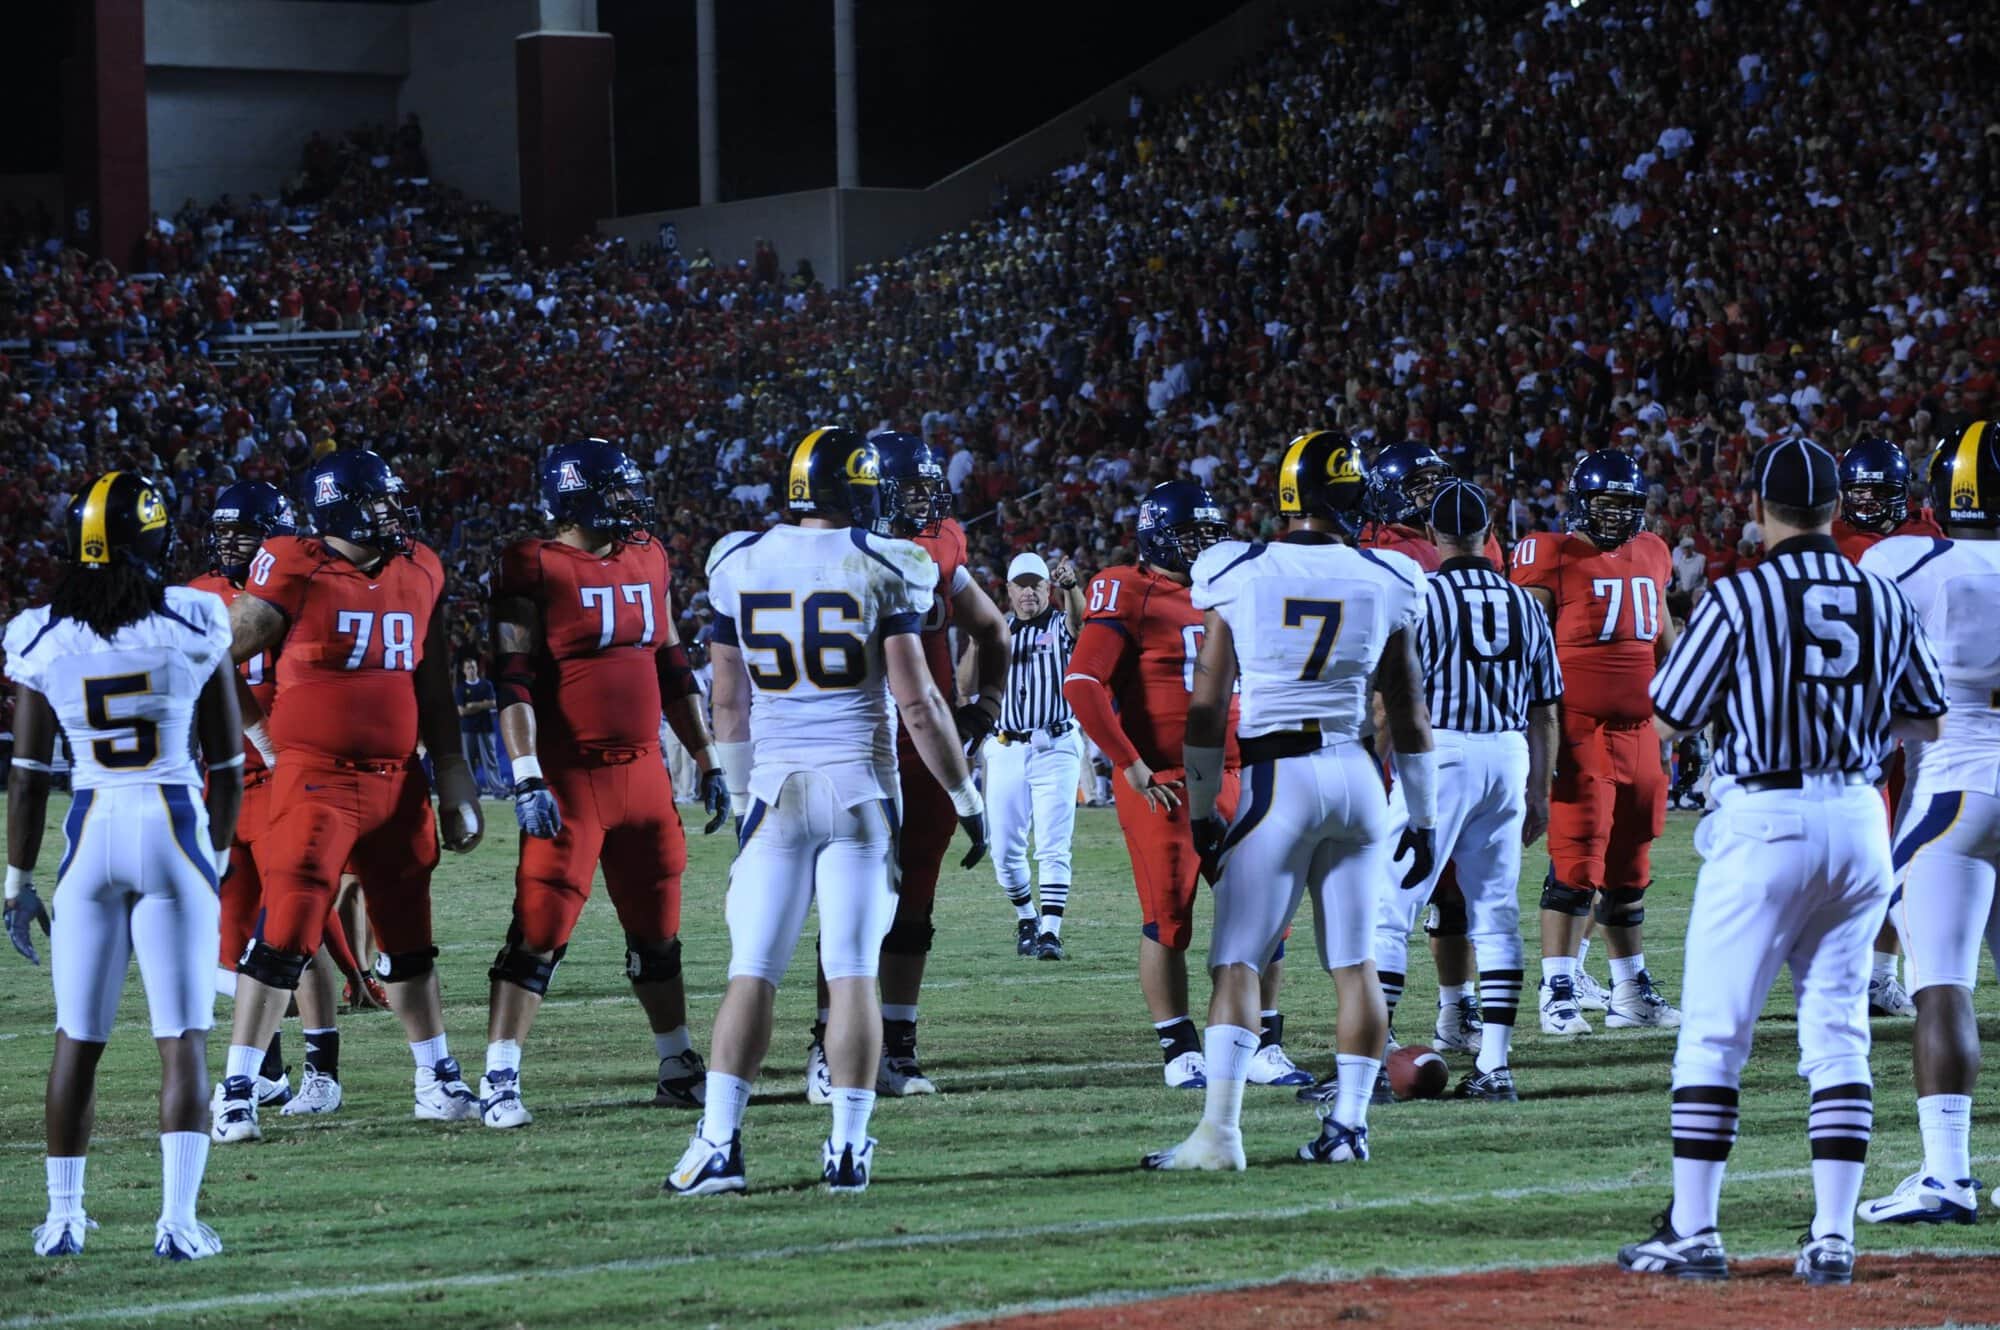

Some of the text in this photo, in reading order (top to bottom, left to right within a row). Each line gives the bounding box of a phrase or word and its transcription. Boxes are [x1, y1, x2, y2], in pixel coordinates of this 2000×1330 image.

[660, 225, 678, 250] 16
[314, 471, 343, 507] A
[558, 460, 587, 493] A
[1326, 448, 1362, 485] Cal
[1138, 499, 1155, 531] A
[1950, 510, 1985, 520] Riddell
[580, 583, 656, 649] 77
[1088, 579, 1121, 612] 61
[1462, 588, 1510, 656] U
[1592, 577, 1659, 642] 70
[337, 610, 415, 671] 78
[740, 592, 866, 691] 56
[1284, 598, 1344, 681] 7
[1803, 584, 1859, 678] S
[84, 672, 158, 769] 5
